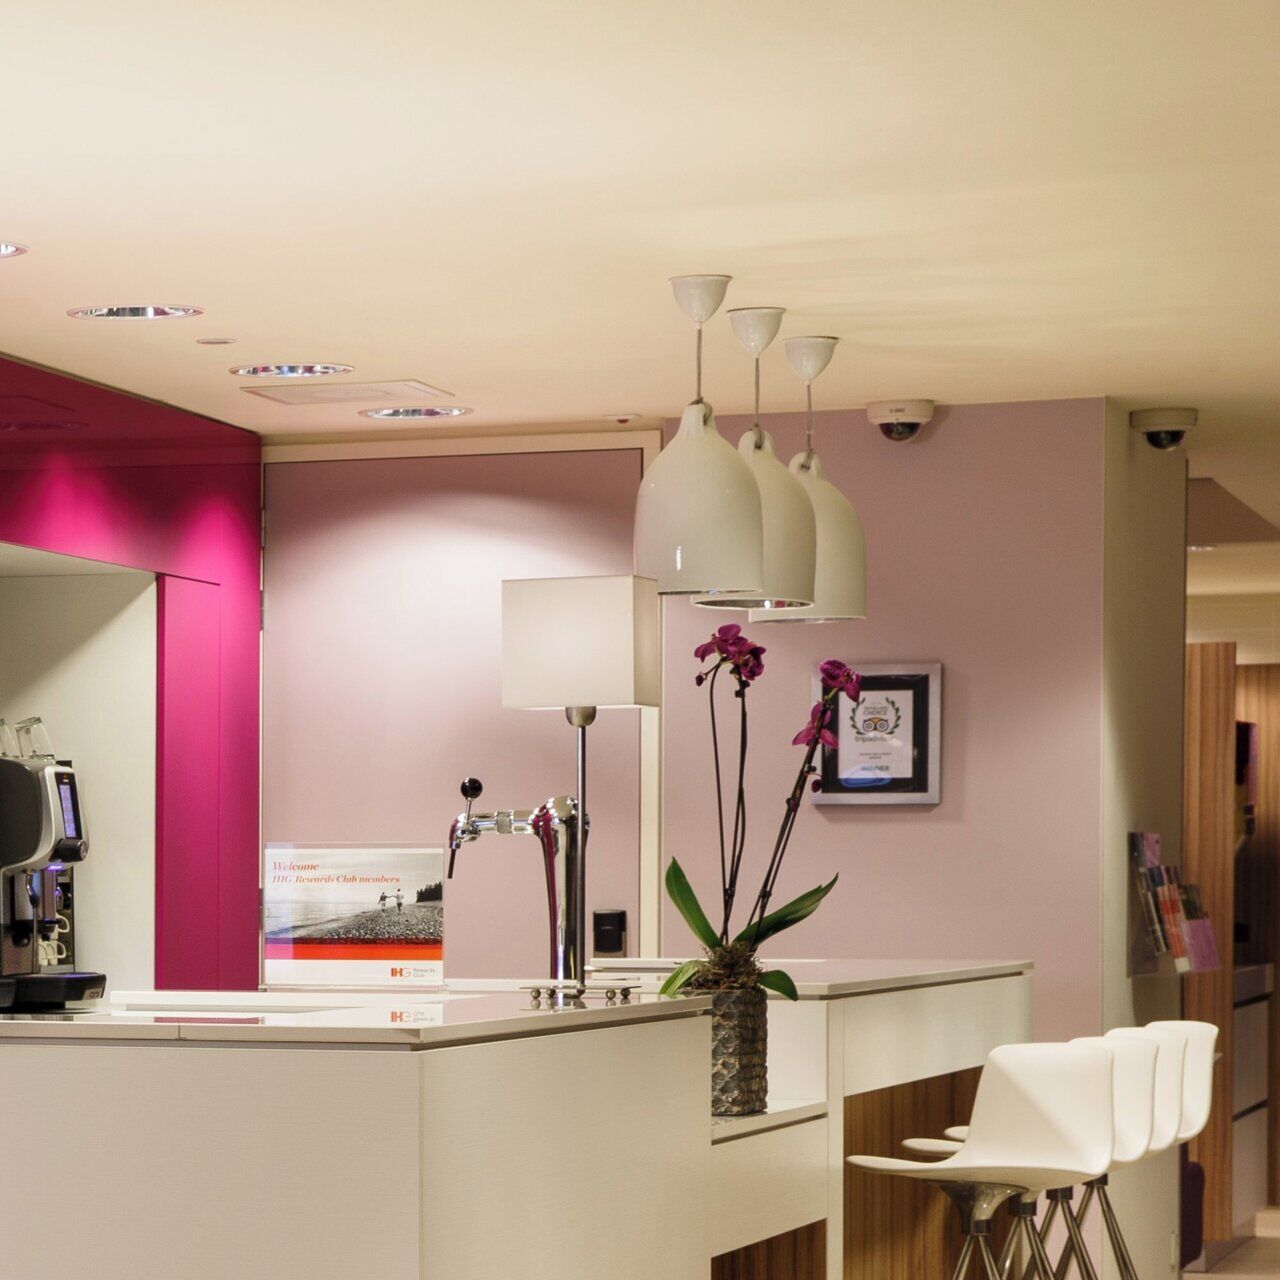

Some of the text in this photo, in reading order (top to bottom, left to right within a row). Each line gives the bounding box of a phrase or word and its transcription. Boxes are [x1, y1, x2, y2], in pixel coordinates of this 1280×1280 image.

[273, 861, 319, 871] Welcome
[295, 874, 334, 883] Rewards
[336, 874, 357, 884] Club
[359, 874, 400, 883] members
[391, 967, 411, 978] IHG
